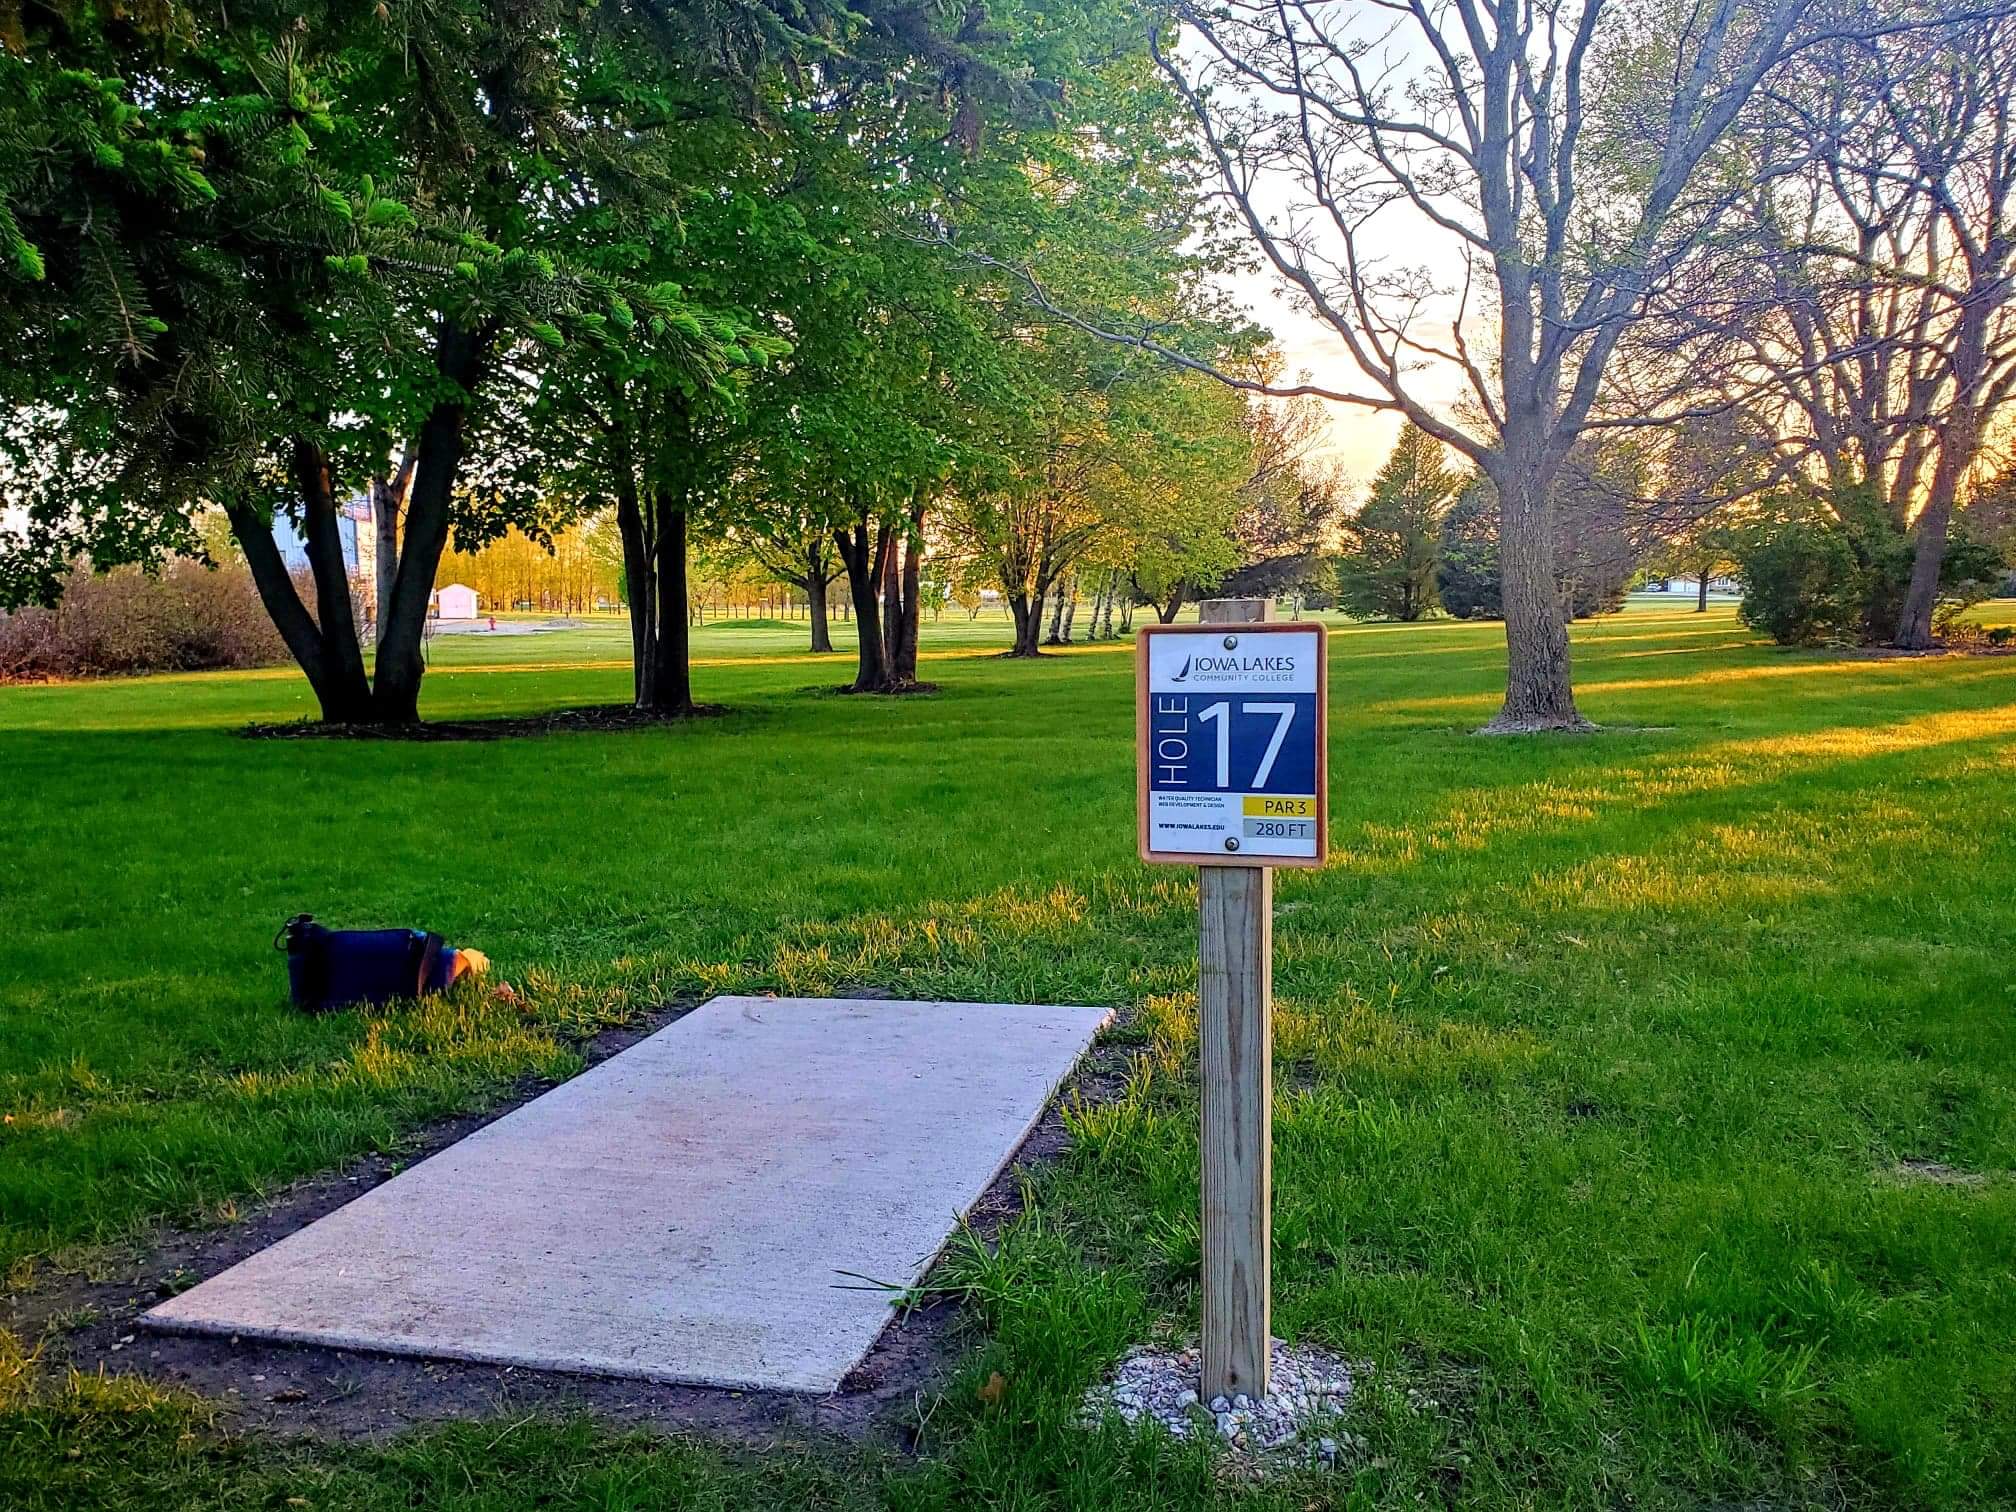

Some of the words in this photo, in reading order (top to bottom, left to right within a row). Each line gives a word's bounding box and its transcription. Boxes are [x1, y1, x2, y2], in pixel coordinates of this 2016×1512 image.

[1195, 657, 1238, 672] IOWA
[1243, 656, 1295, 671] LAKES
[1193, 674, 1249, 682] COMMUNITY
[1252, 674, 1295, 682] COLLEGE
[1158, 696, 1188, 784] HOLE
[1198, 701, 1296, 789] 17
[1265, 800, 1295, 814] PAR
[1297, 801, 1306, 815] 3
[1158, 823, 1225, 831] WWW.IOWALAKES.EDU
[1255, 822, 1285, 836] 280
[1288, 823, 1307, 837] FT
